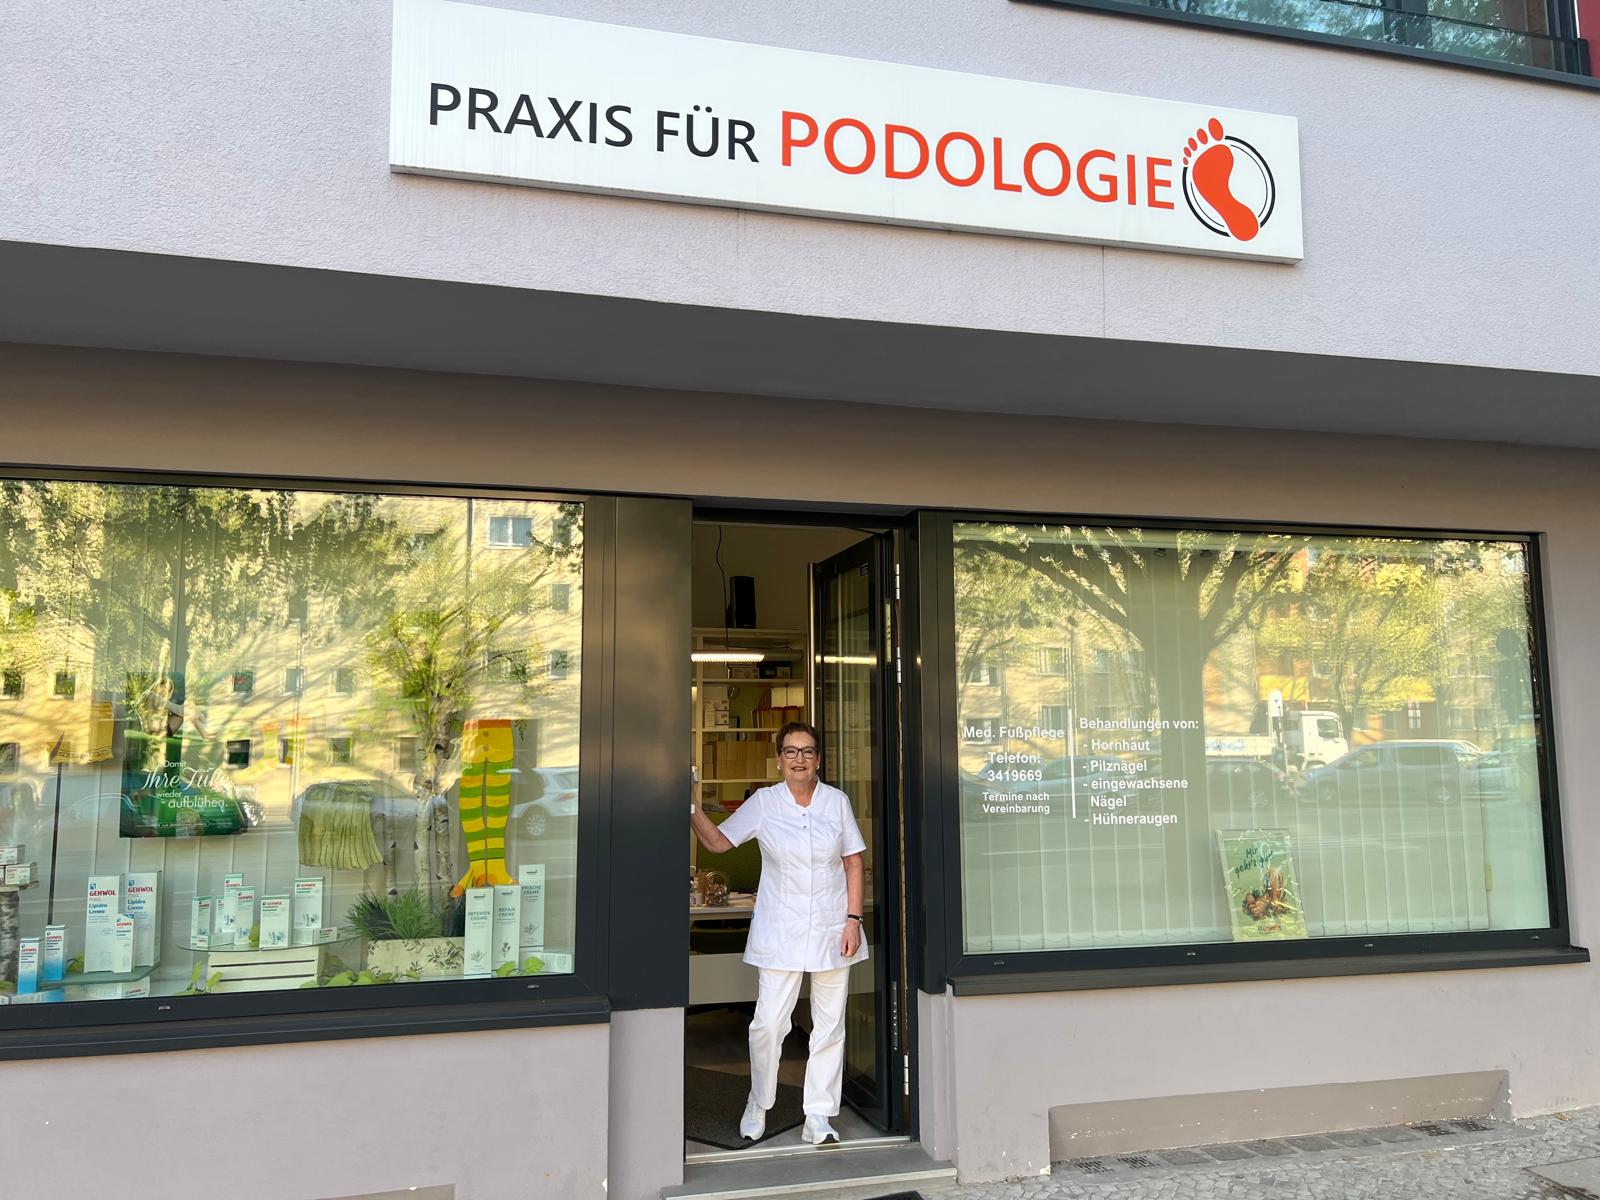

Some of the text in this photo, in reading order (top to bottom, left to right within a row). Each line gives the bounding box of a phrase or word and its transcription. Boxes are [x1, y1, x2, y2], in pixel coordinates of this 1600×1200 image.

[429, 82, 1175, 210] PRAXIS FÜR PODOLOGIE
[1079, 717, 1199, 732] Behandlungen von:
[963, 726, 1065, 741] Med. Fußpflege
[1091, 738, 1150, 751] Hornhaut
[163, 760, 186, 768] Damit
[987, 751, 1041, 764] Telefon:
[1090, 760, 1147, 774] Pilznägel
[140, 767, 180, 790] Ihre
[987, 769, 1042, 782] 3419669
[1091, 778, 1188, 792] eingewachsene
[155, 790, 182, 799] wieder
[982, 791, 1050, 801] Termine nach
[168, 795, 229, 809] aufblühen.
[982, 803, 1050, 815] Vereinbarung
[1090, 795, 1127, 809] Nägel
[1093, 813, 1178, 827] Hühneraugen
